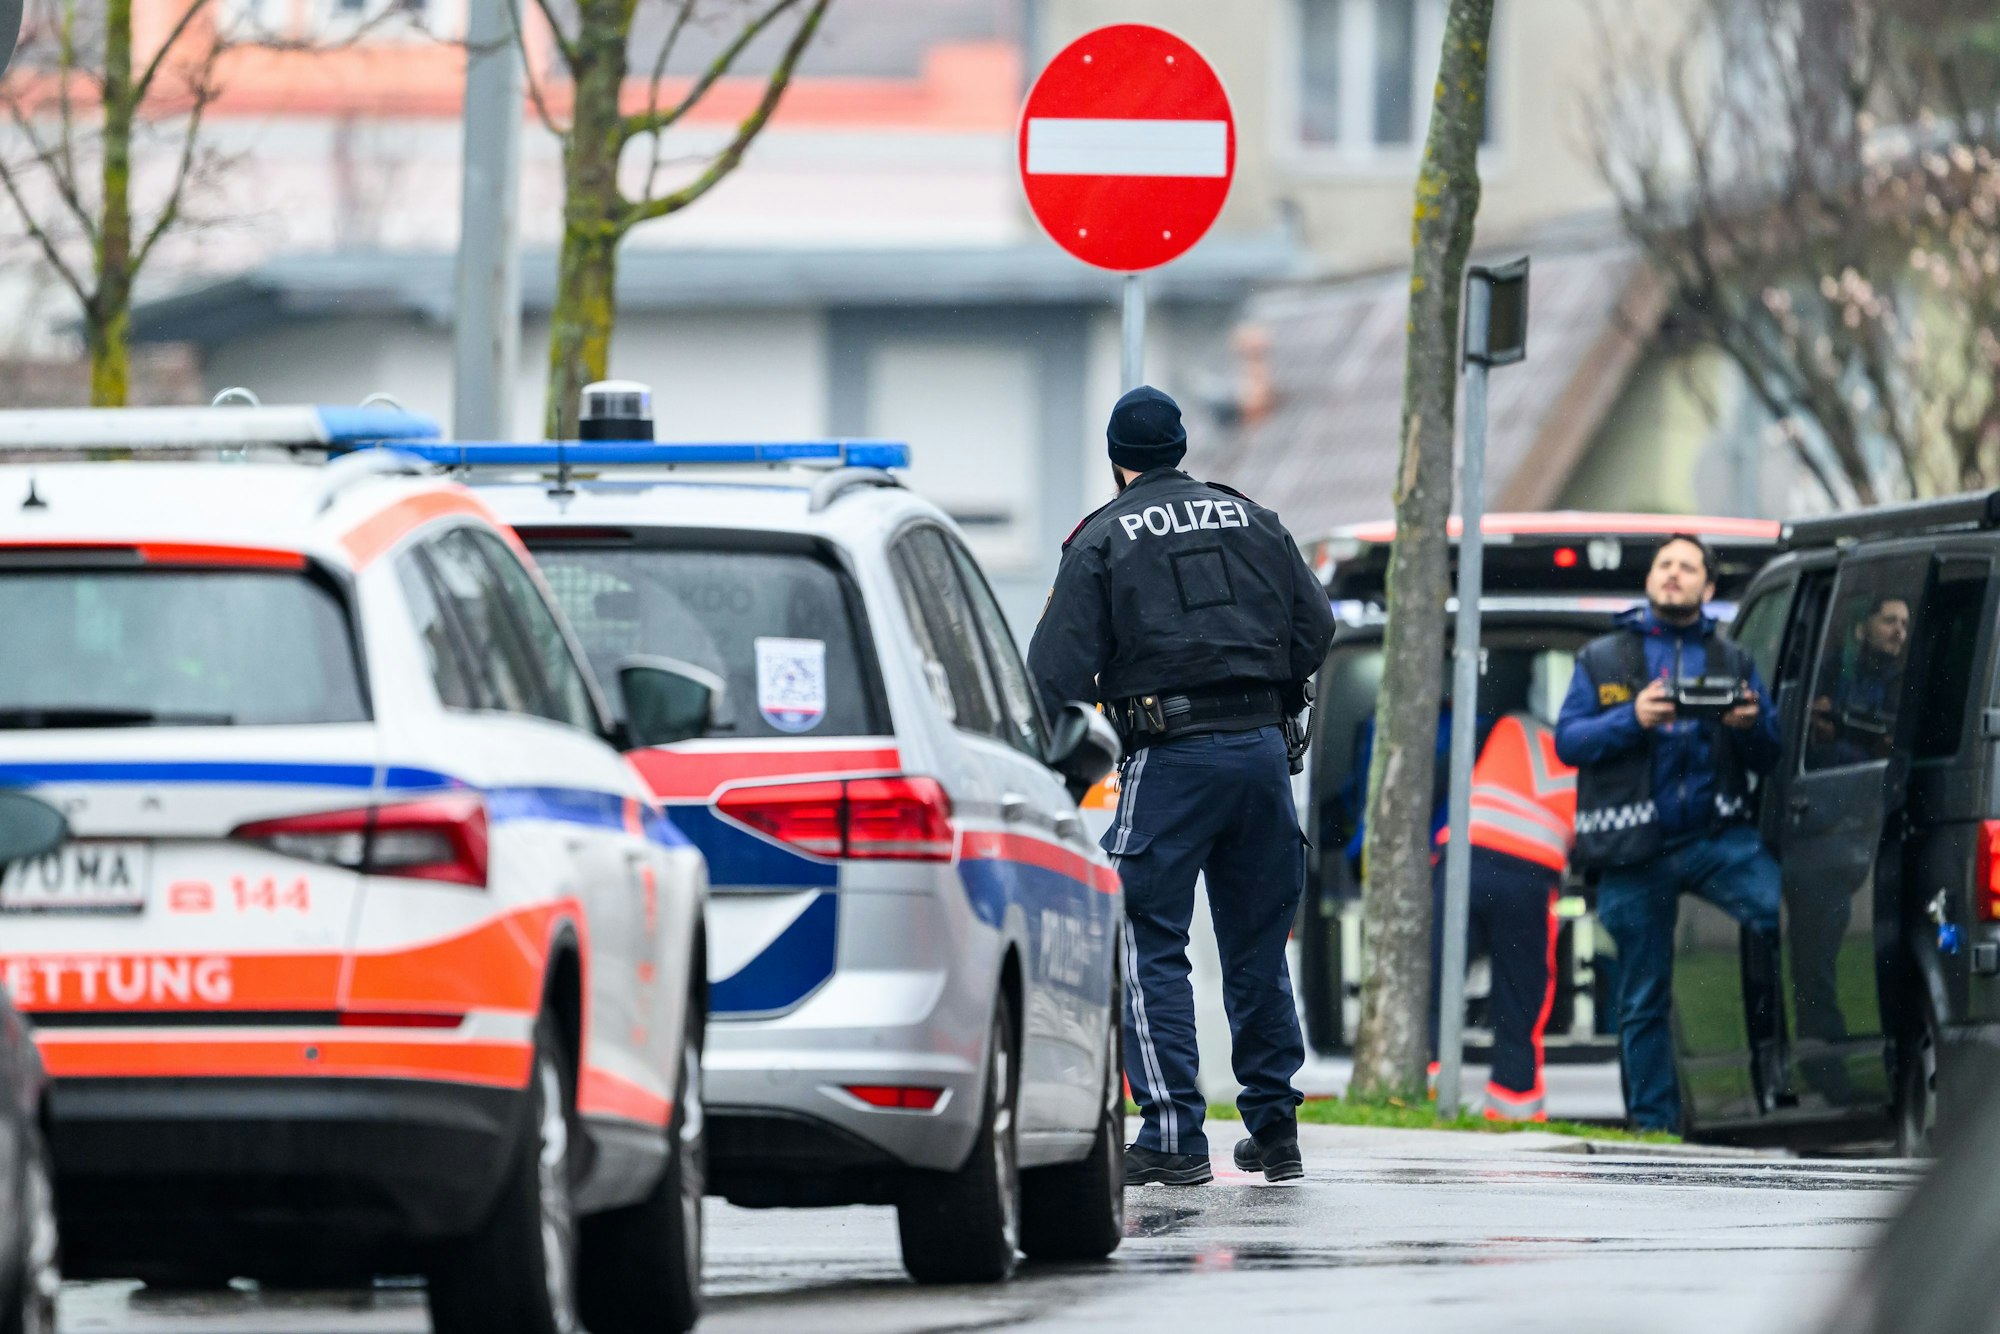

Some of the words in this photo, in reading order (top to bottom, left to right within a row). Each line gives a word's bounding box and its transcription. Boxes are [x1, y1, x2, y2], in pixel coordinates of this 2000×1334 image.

[1118, 499, 1249, 541] POLIZEI
[231, 875, 311, 914] 144
[4, 956, 234, 1003] ETTUNG
